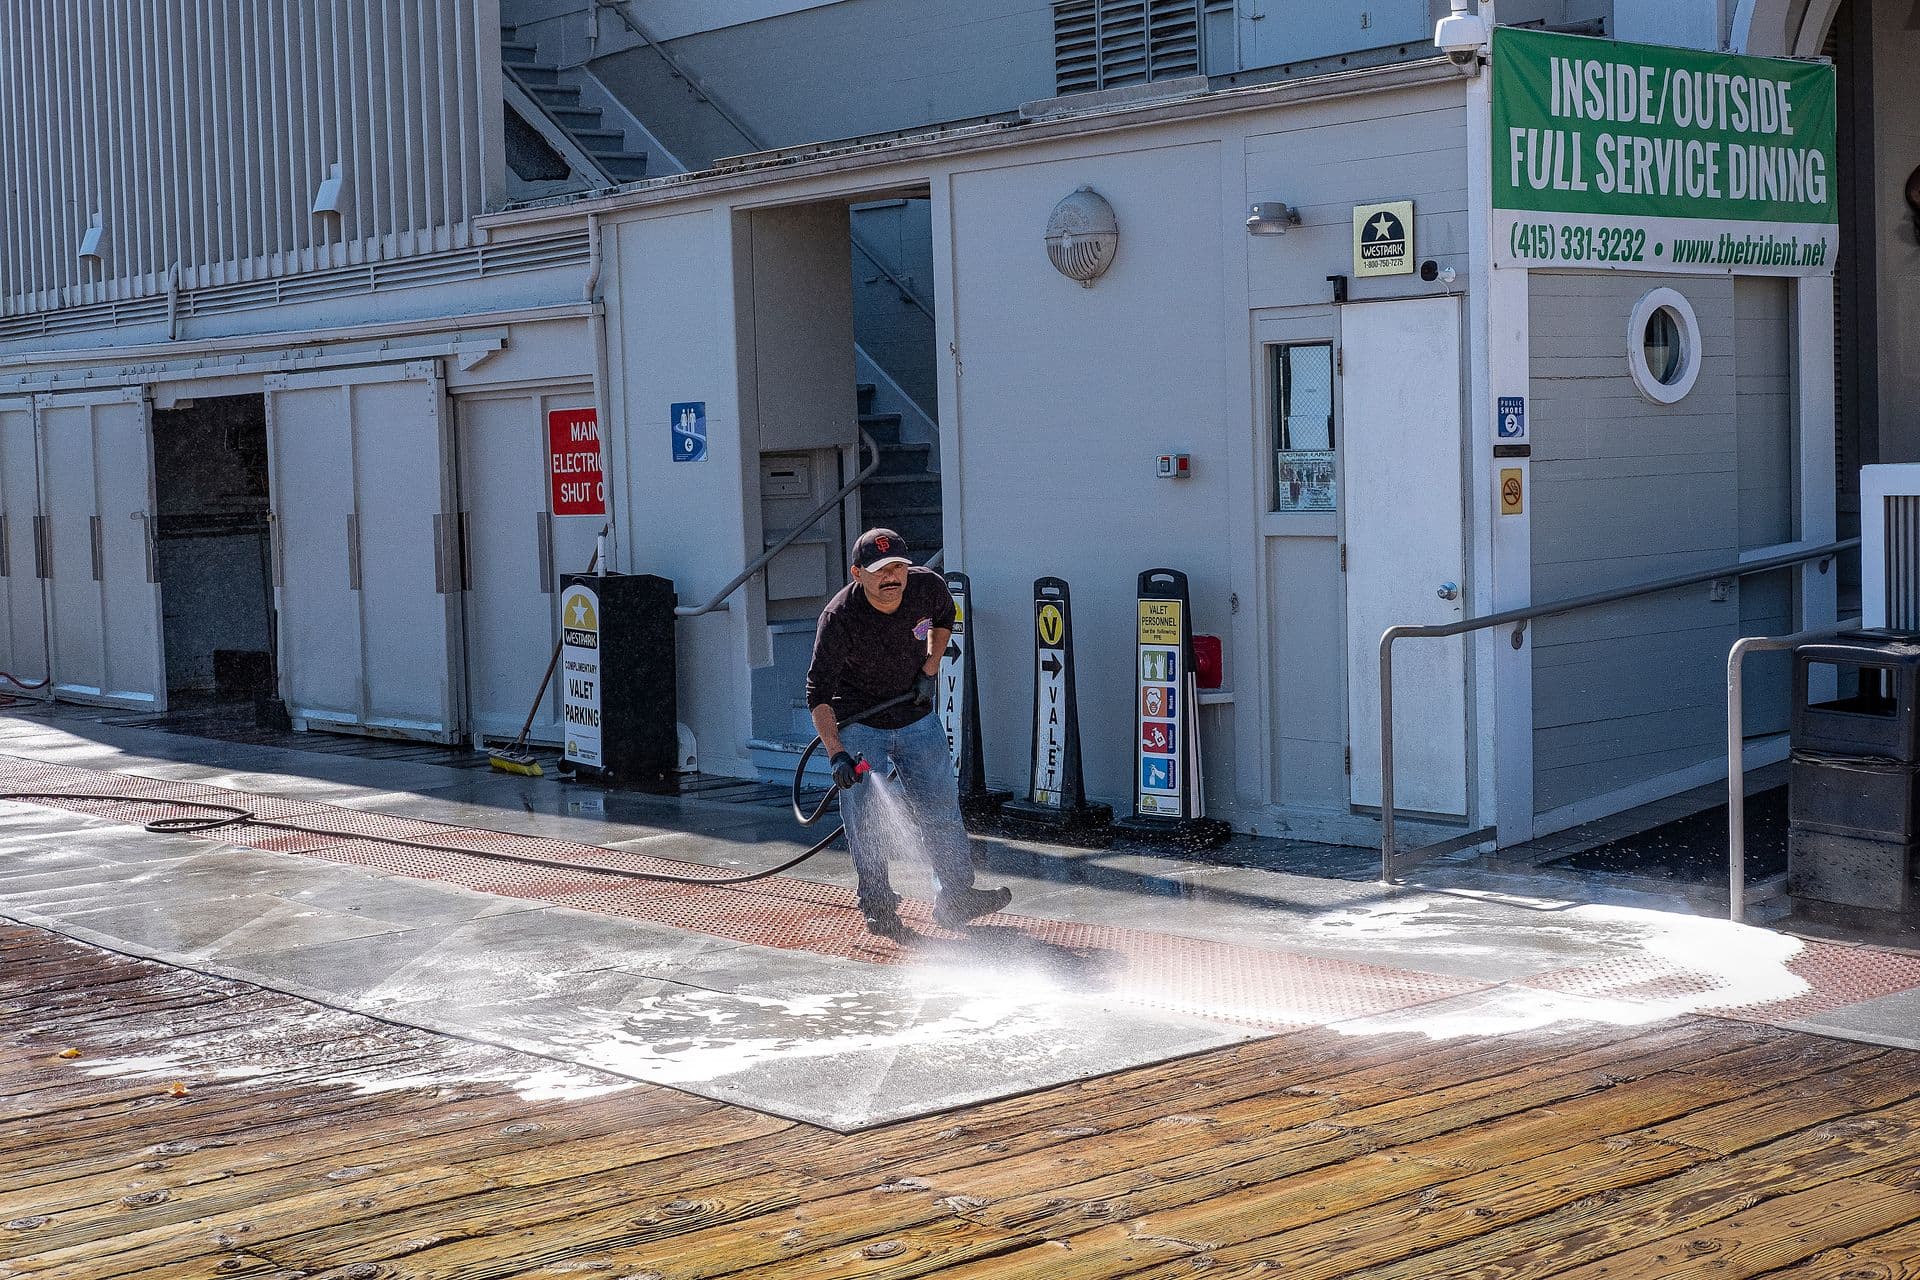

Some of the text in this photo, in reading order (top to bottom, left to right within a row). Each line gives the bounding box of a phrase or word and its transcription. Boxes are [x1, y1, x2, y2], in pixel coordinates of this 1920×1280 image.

[1550, 56, 1794, 136] INSIDE/OUTSIDE
[1509, 127, 1827, 204] FULL SERVICE DINING
[1362, 243, 1404, 257] WESTPARK
[1510, 221, 1827, 267] (415) 331-3232 www.thetrident.net
[1501, 406, 1523, 415] SHORE
[570, 420, 600, 442] MAIN
[561, 482, 591, 503] SHUT
[1149, 604, 1169, 615] VALET
[1043, 616, 1058, 641] V
[1141, 616, 1177, 627] PERSONNEL
[565, 630, 597, 648] WESTPARK
[565, 659, 598, 674] COMPLIMENTARY
[568, 678, 594, 701] VALET
[565, 703, 600, 728] PARKING
[945, 675, 956, 757] VALE
[1047, 686, 1058, 787] VALET
